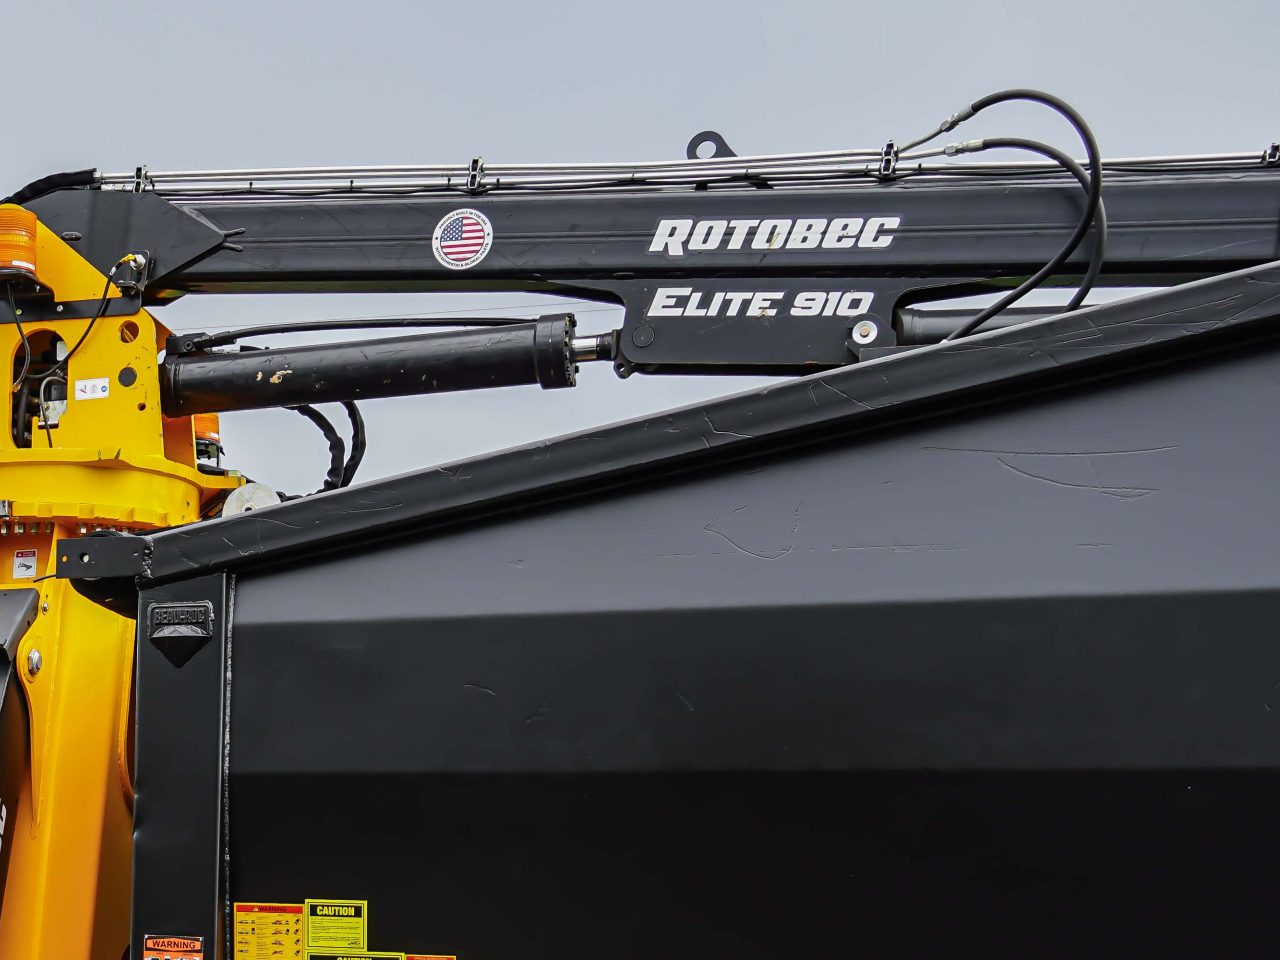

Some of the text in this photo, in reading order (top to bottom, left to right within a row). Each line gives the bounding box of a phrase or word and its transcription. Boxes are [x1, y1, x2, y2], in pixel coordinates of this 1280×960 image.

[648, 217, 901, 256] ROTOBEC
[647, 287, 874, 317] ELITE 910
[317, 906, 355, 916] CAUTION
[152, 940, 196, 949] WARNING
